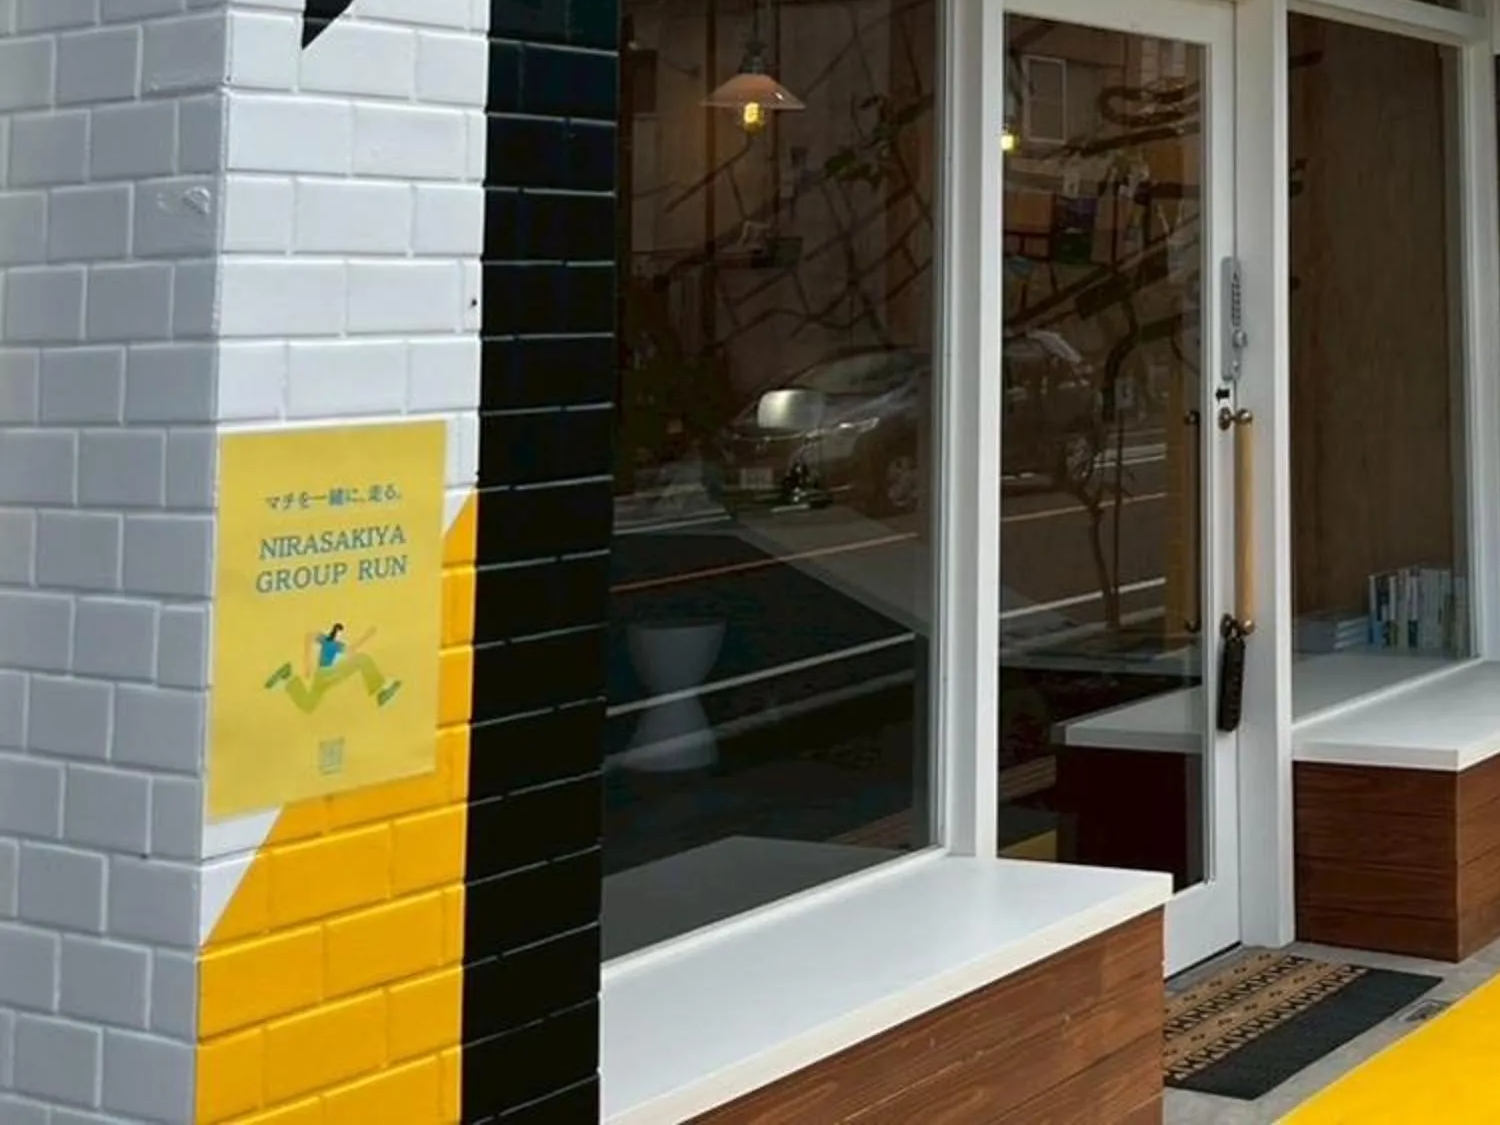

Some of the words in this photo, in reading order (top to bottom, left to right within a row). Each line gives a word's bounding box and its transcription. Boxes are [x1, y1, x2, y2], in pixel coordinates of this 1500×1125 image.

[259, 523, 406, 560] NIRASAKIYA
[256, 562, 348, 594] GROUP
[357, 554, 408, 581] RUN
